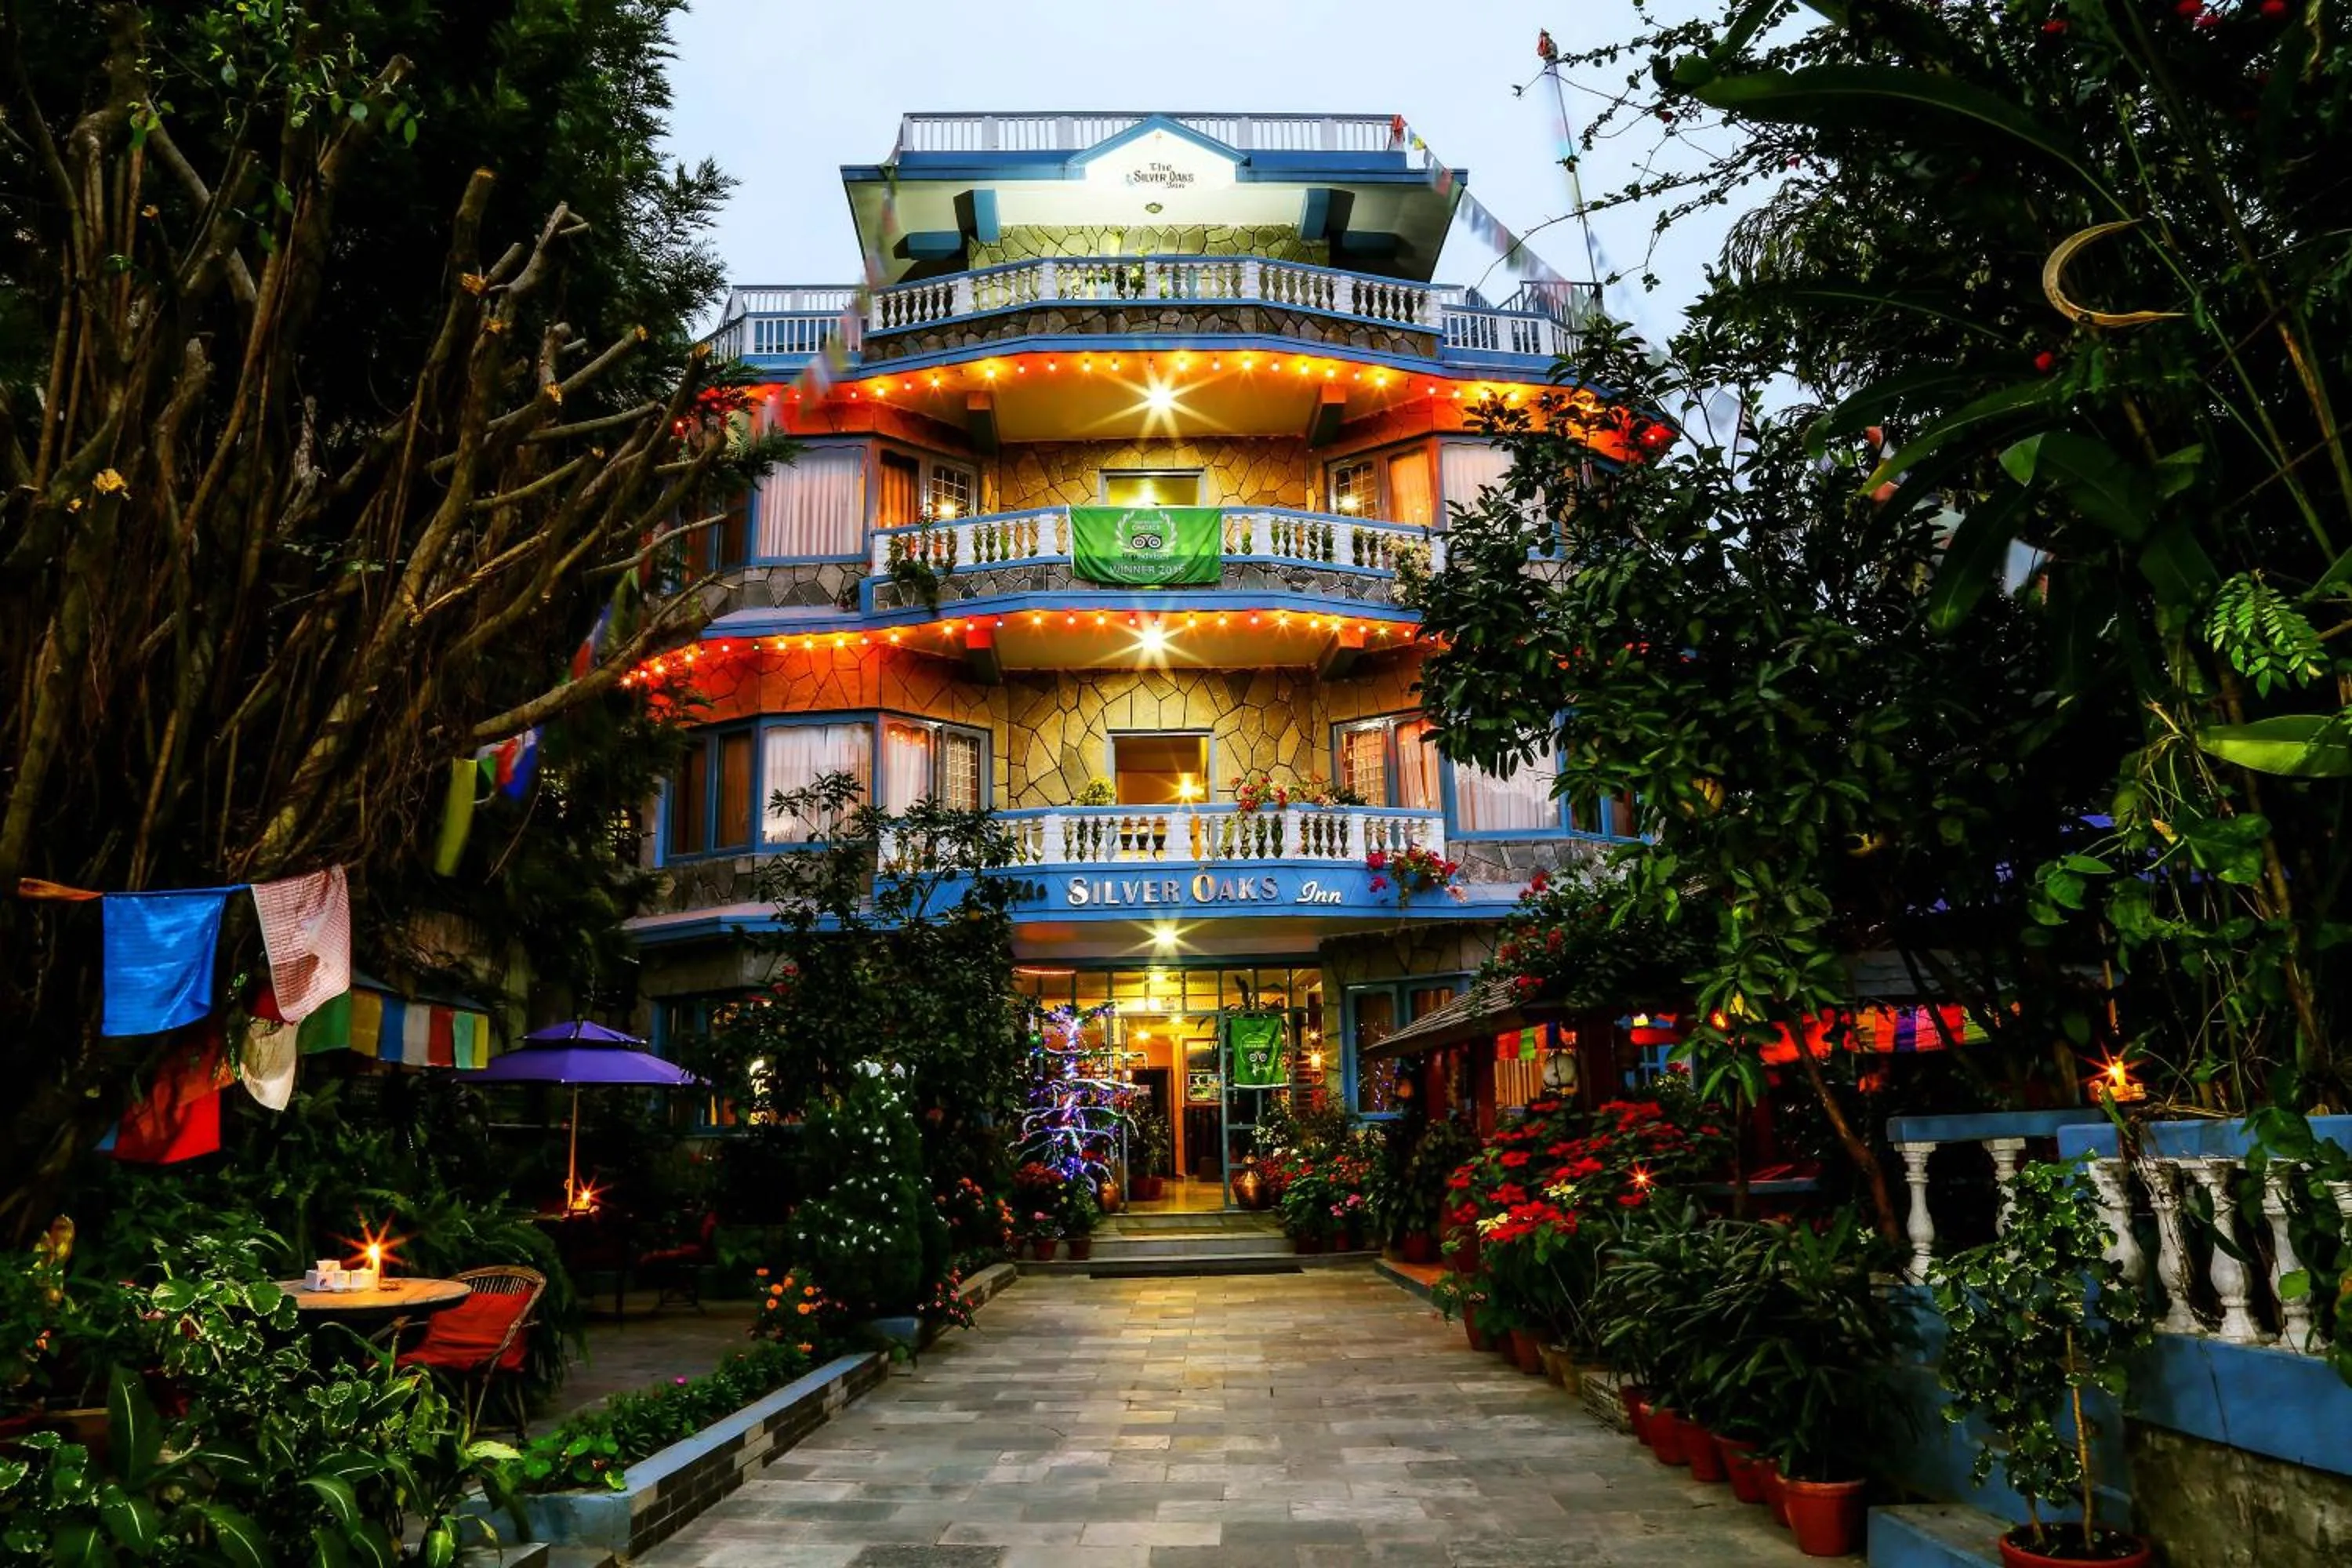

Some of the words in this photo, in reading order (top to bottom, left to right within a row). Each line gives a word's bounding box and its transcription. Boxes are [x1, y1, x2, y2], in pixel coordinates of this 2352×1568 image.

[1149, 162, 1172, 171] The
[1134, 169, 1167, 182] SILVER
[1169, 170, 1195, 183] OAKS
[1109, 564, 1155, 575] WINNER
[1068, 876, 1181, 906] SILVER
[1192, 873, 1279, 903] OAKS
[1295, 880, 1342, 905] Inn
